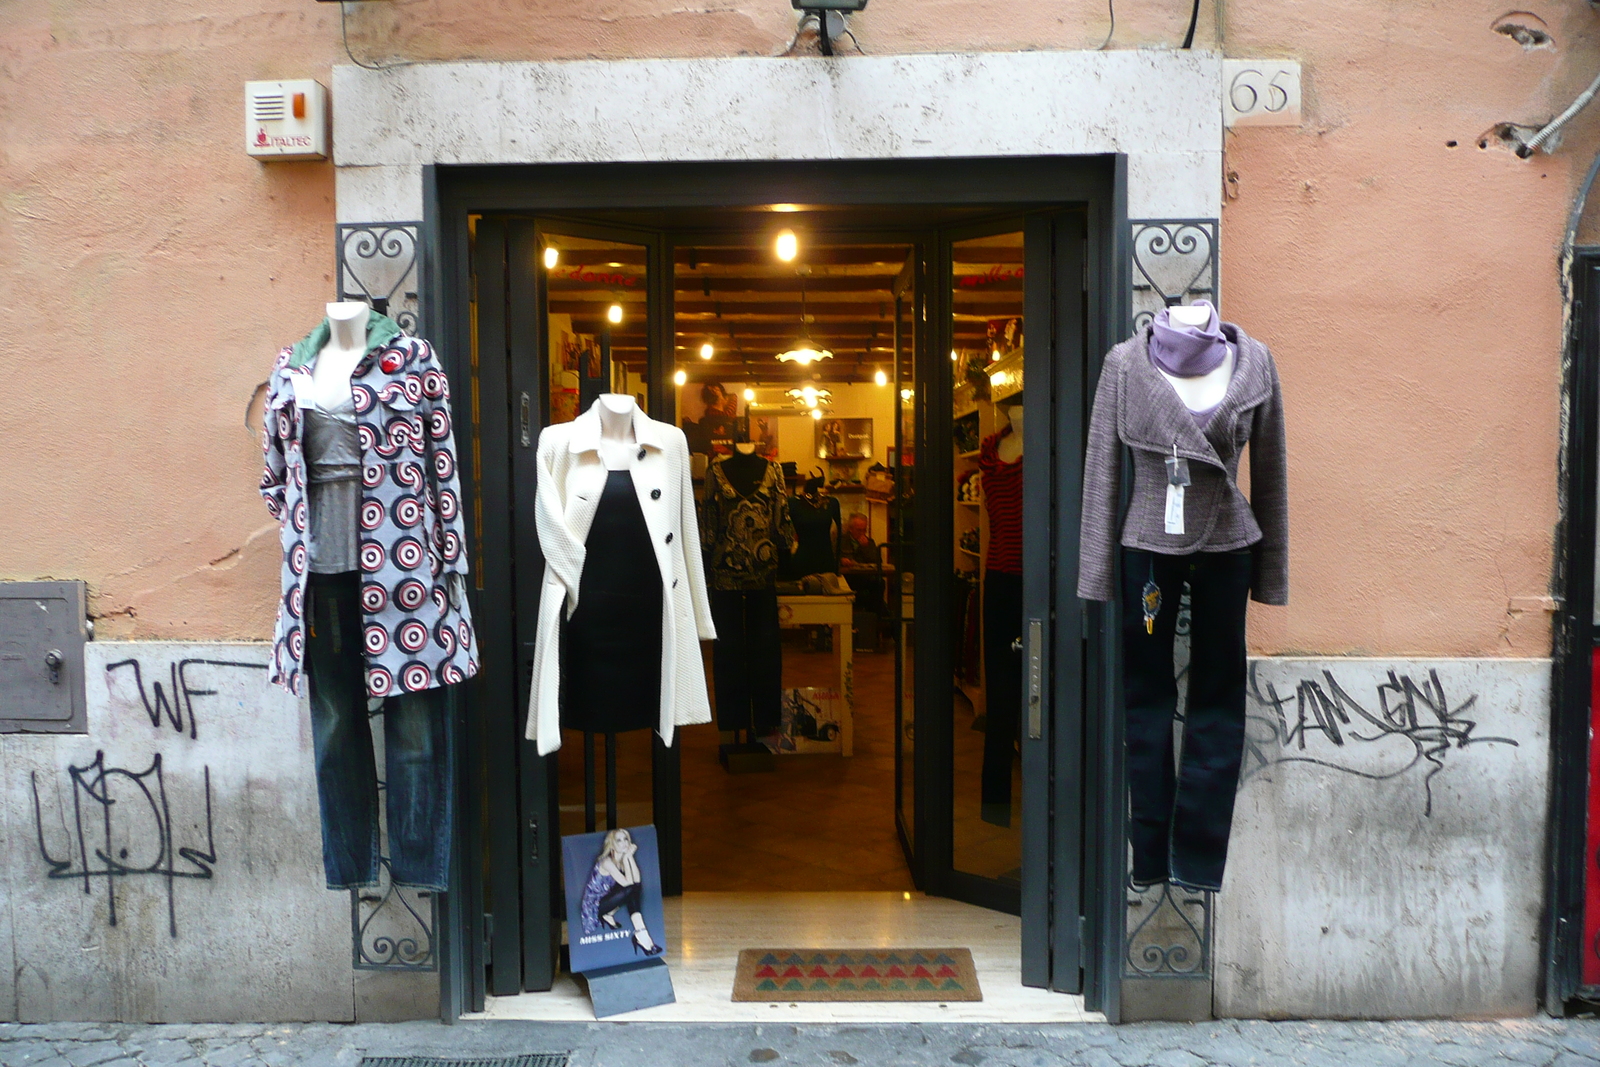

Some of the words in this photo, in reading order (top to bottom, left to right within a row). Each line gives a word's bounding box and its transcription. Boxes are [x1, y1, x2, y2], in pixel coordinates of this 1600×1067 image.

[1229, 68, 1290, 113] 65
[569, 264, 637, 286] donne
[579, 935, 603, 945] MISS
[604, 929, 631, 941] SIXTY
